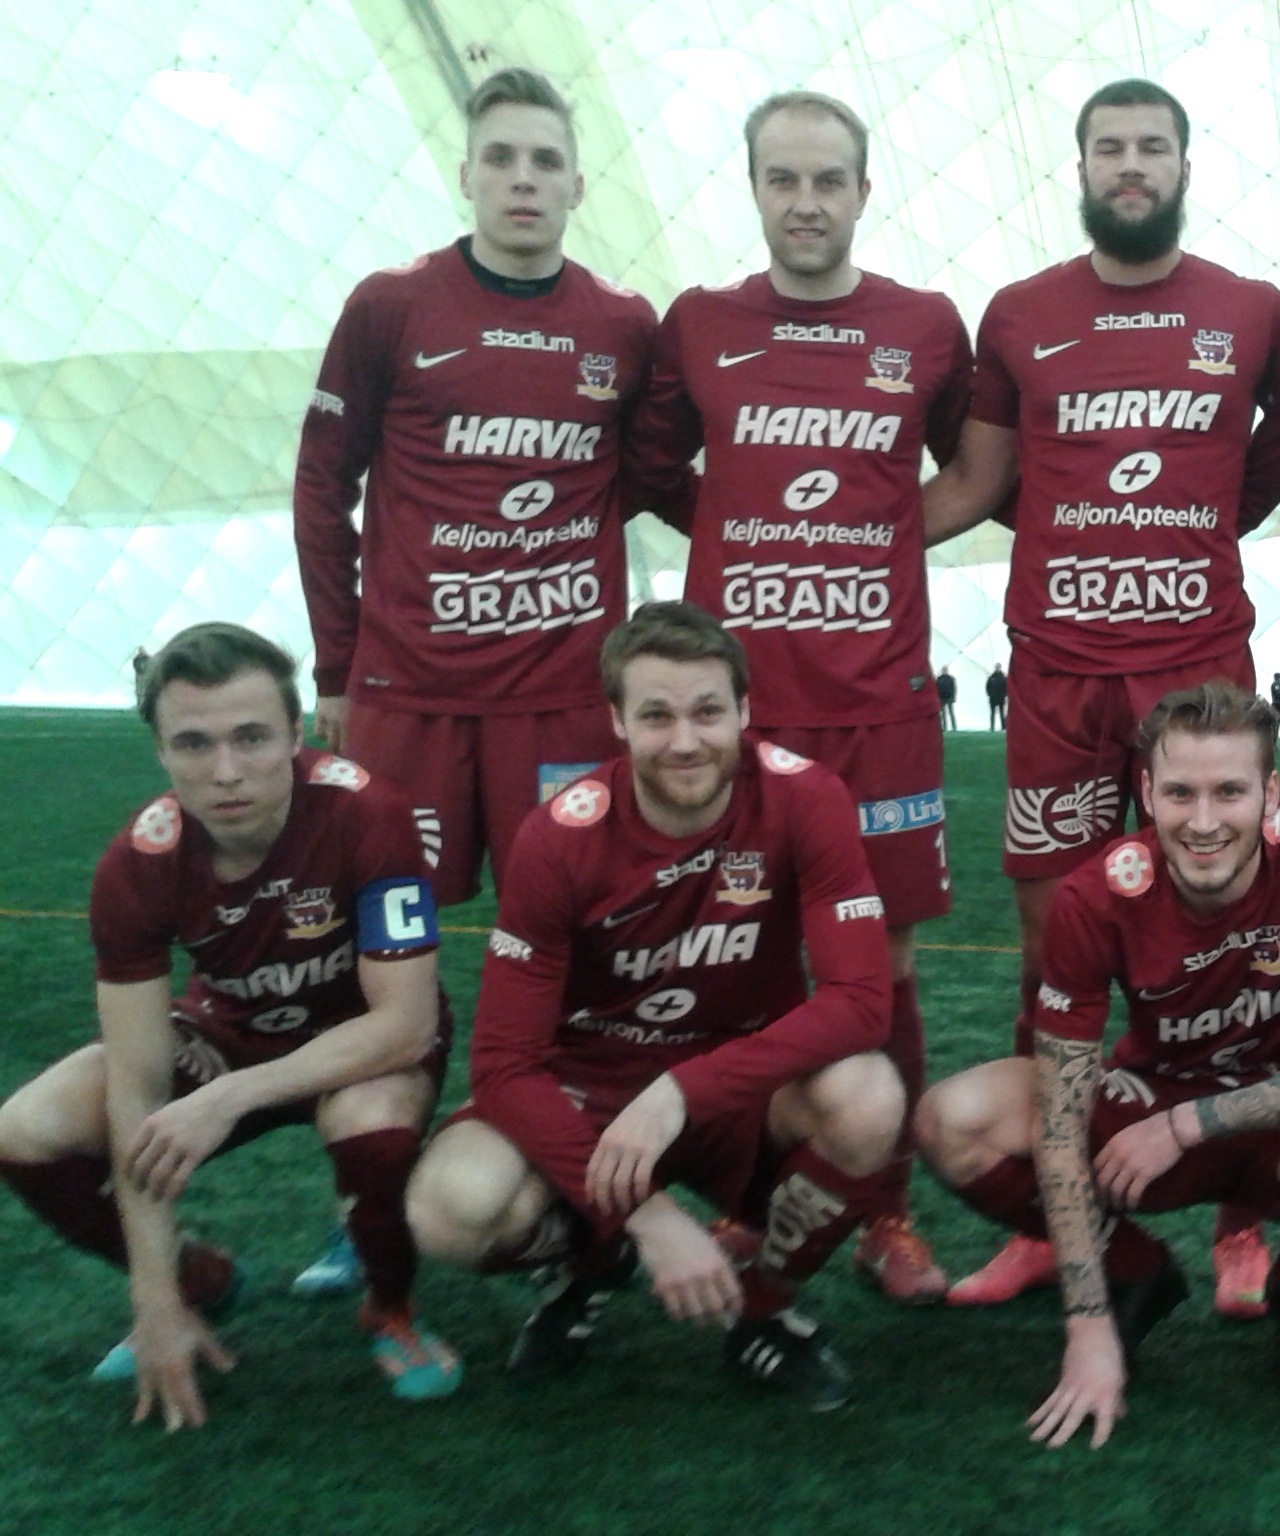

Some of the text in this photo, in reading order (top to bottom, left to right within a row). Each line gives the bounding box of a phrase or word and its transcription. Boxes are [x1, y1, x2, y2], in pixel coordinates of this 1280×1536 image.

[481, 328, 575, 353] stadium
[772, 322, 866, 345] stadium
[1094, 312, 1186, 331] stadium
[733, 405, 902, 453] HARVIA
[1056, 389, 1222, 434] HARVIA
[444, 414, 602, 461] HARVIA
[431, 516, 599, 553] KeljonAptekki
[721, 518, 895, 547] KeljonApteekki
[1053, 503, 1219, 531] KeljonApteekki
[432, 573, 600, 622] GRANO
[723, 577, 890, 619] GRANO
[1049, 570, 1209, 610] GRANO
[383, 884, 426, 941] C
[613, 921, 761, 982] HAVIA
